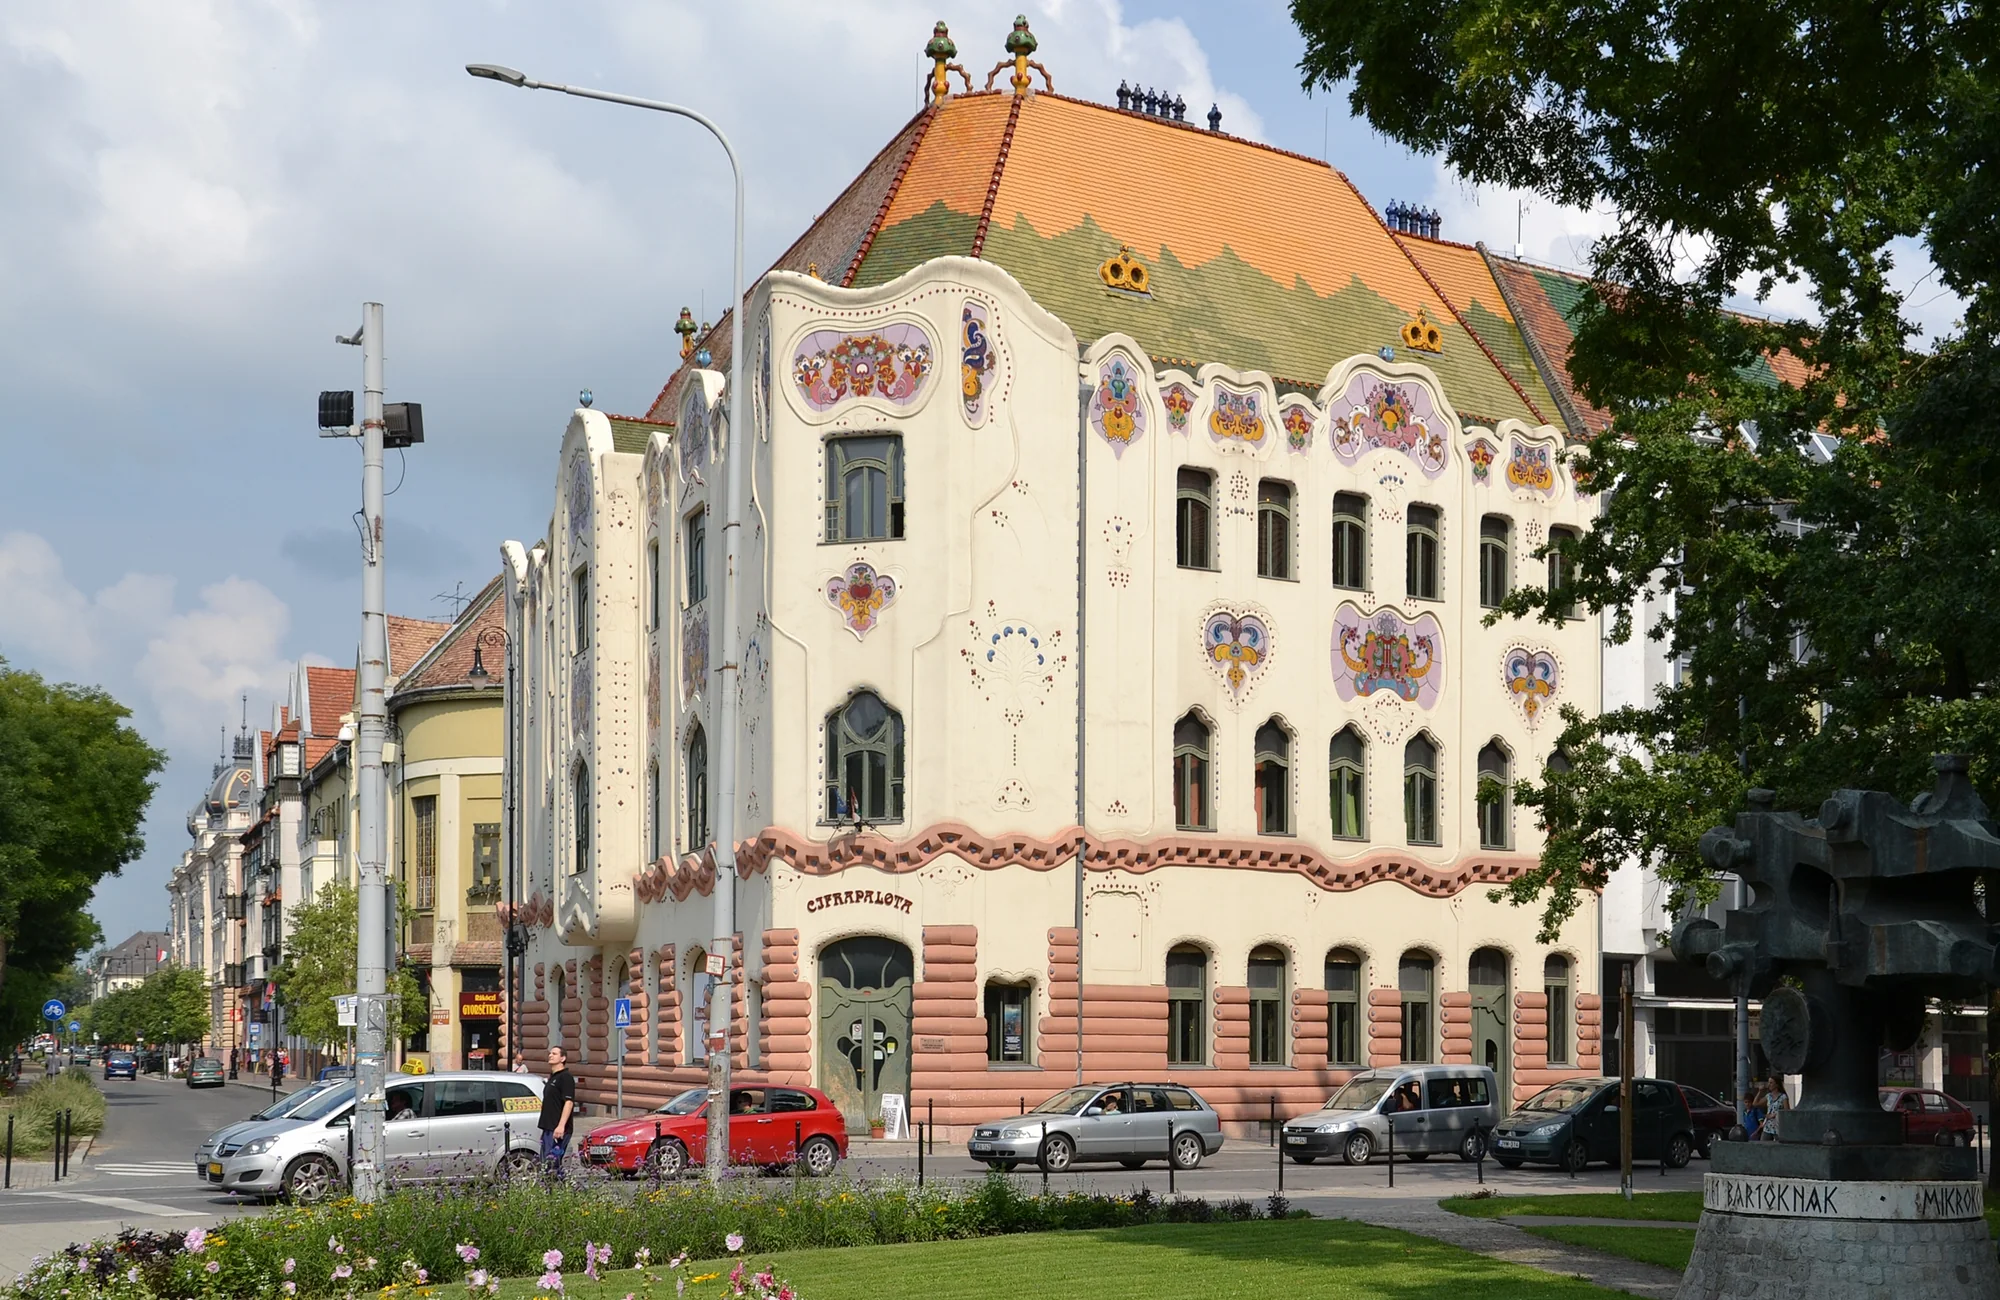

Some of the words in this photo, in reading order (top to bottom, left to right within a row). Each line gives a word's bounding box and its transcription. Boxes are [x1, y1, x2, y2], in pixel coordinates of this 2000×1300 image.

[807, 889, 914, 915] CIFRAPALOTA
[504, 1099, 514, 1111] G
[1727, 1181, 1838, 1214] BARTÓKNAK
